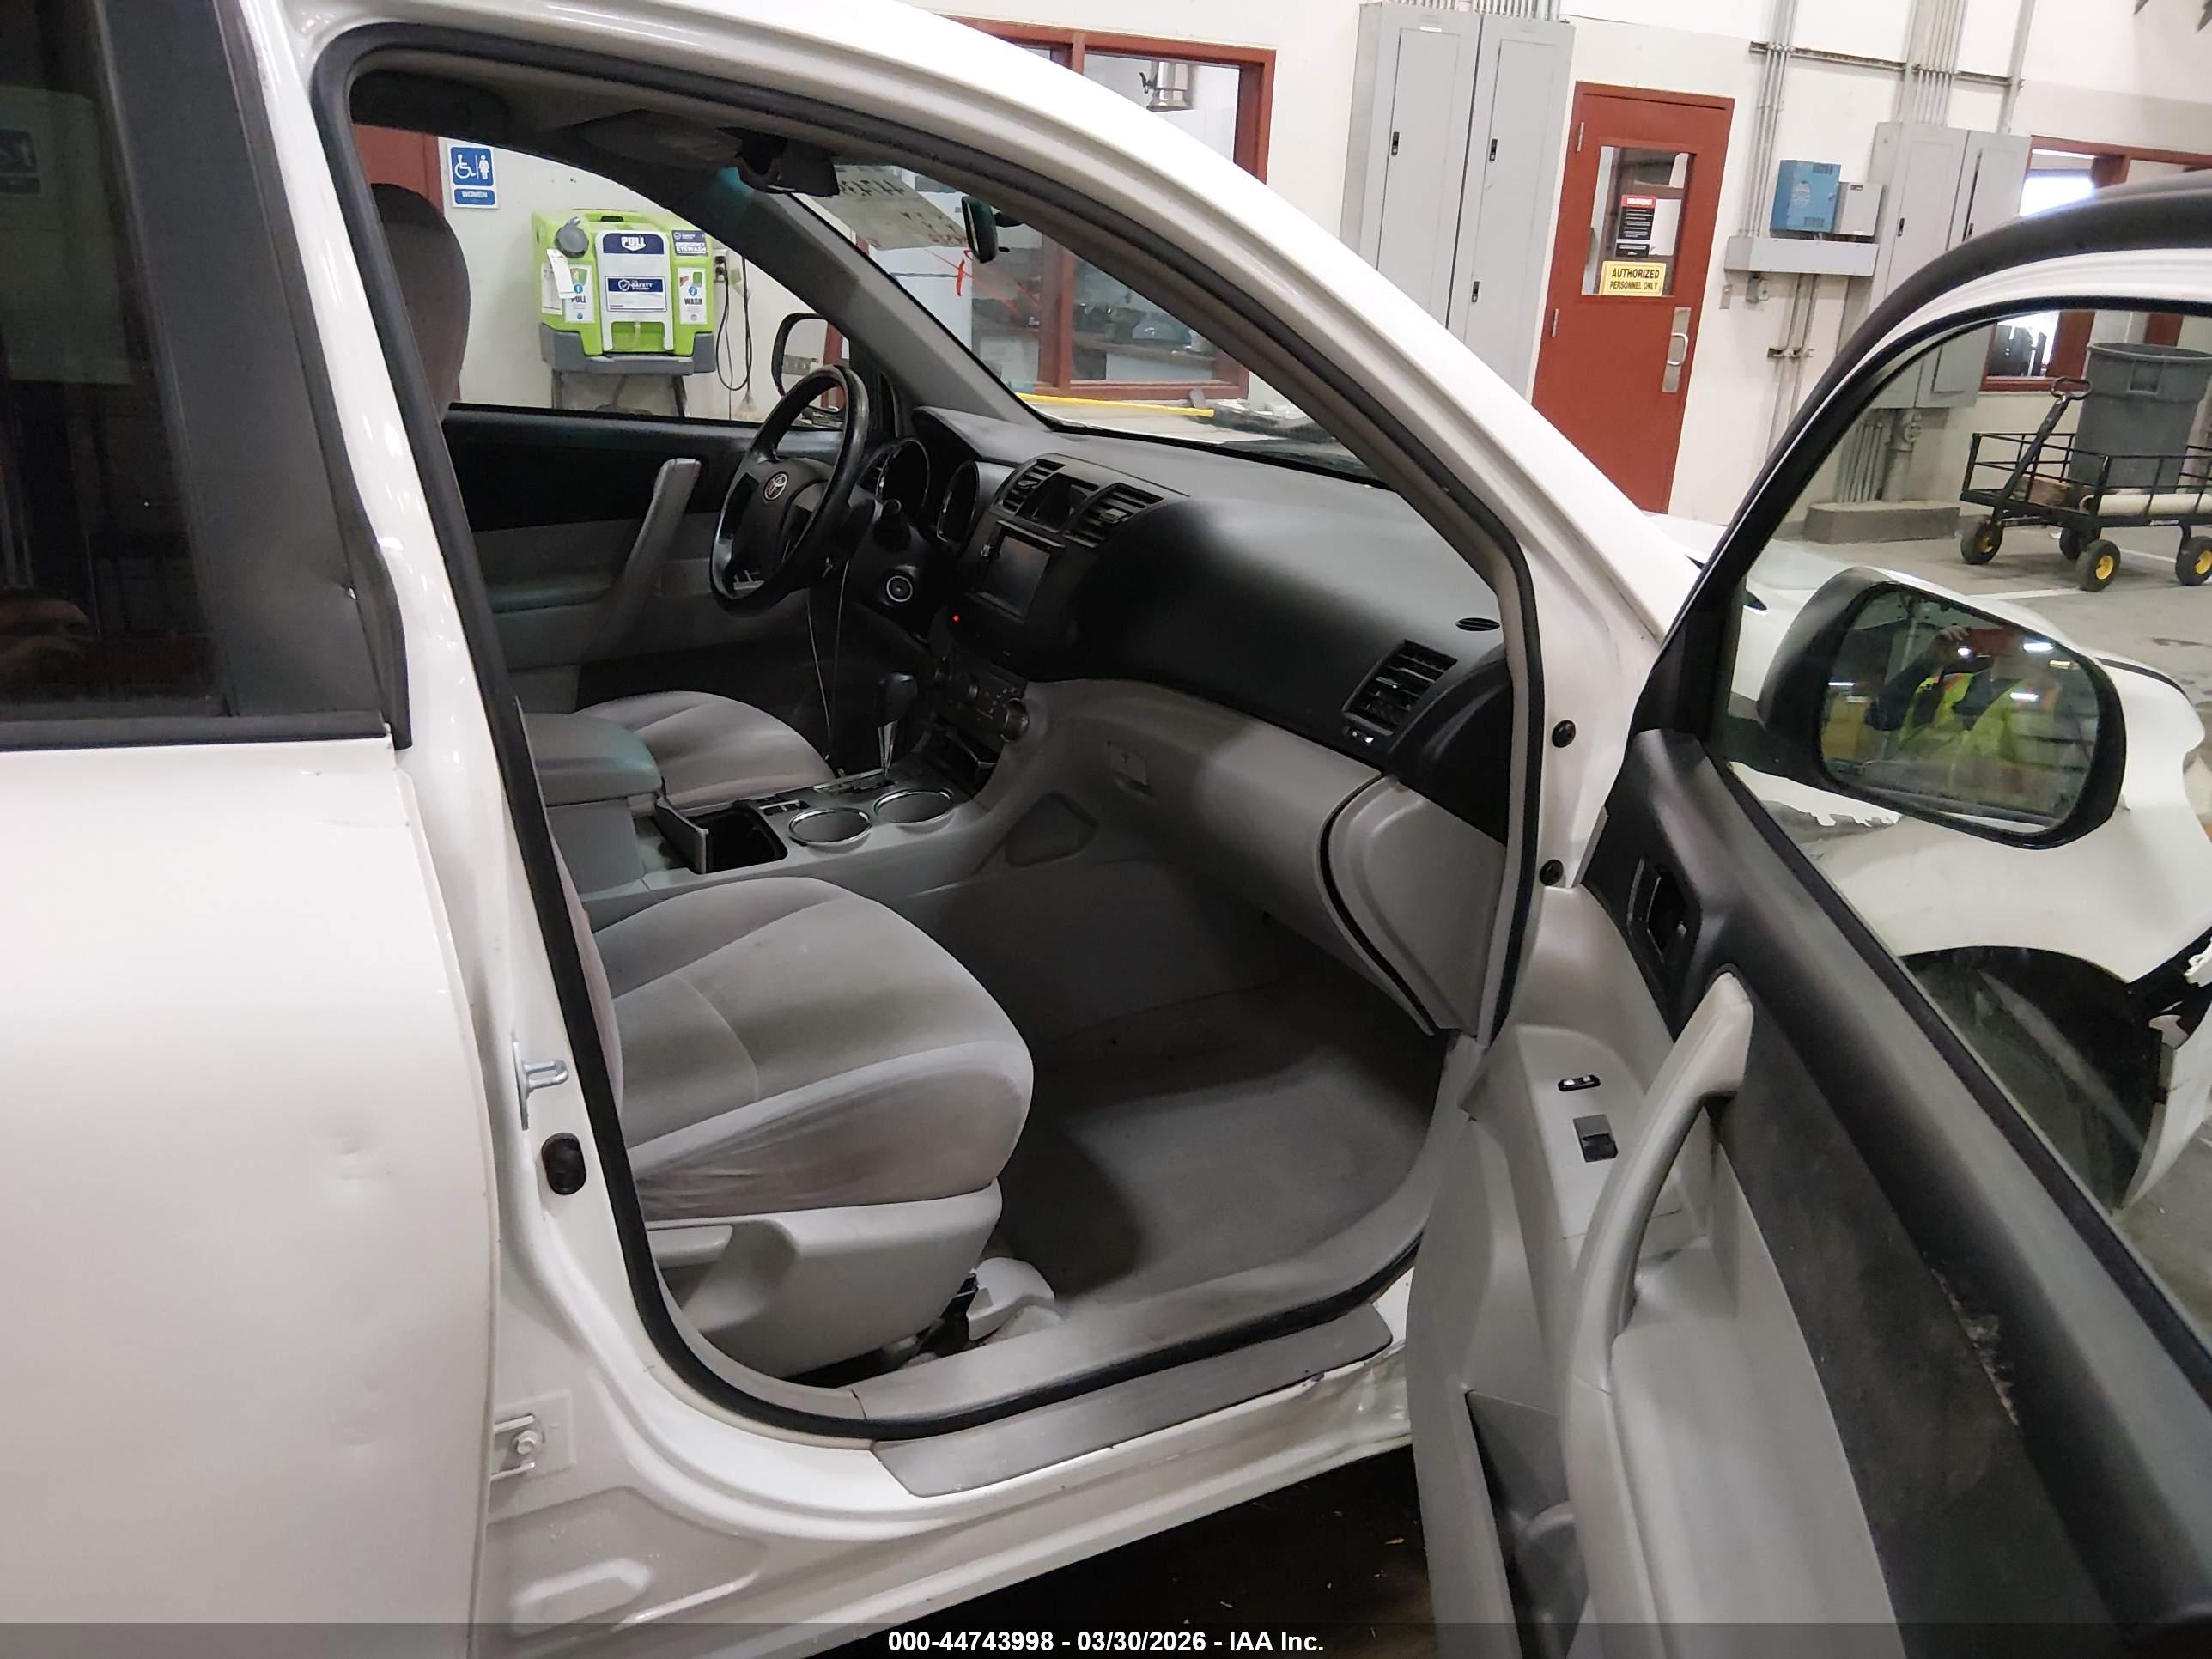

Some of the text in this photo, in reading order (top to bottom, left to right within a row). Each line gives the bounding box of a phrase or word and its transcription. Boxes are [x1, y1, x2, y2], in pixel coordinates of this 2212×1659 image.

[621, 236, 646, 246] PULL
[1612, 268, 1660, 279] AUTHORIZED
[1609, 281, 1658, 290] PERSONNEL ONLY
